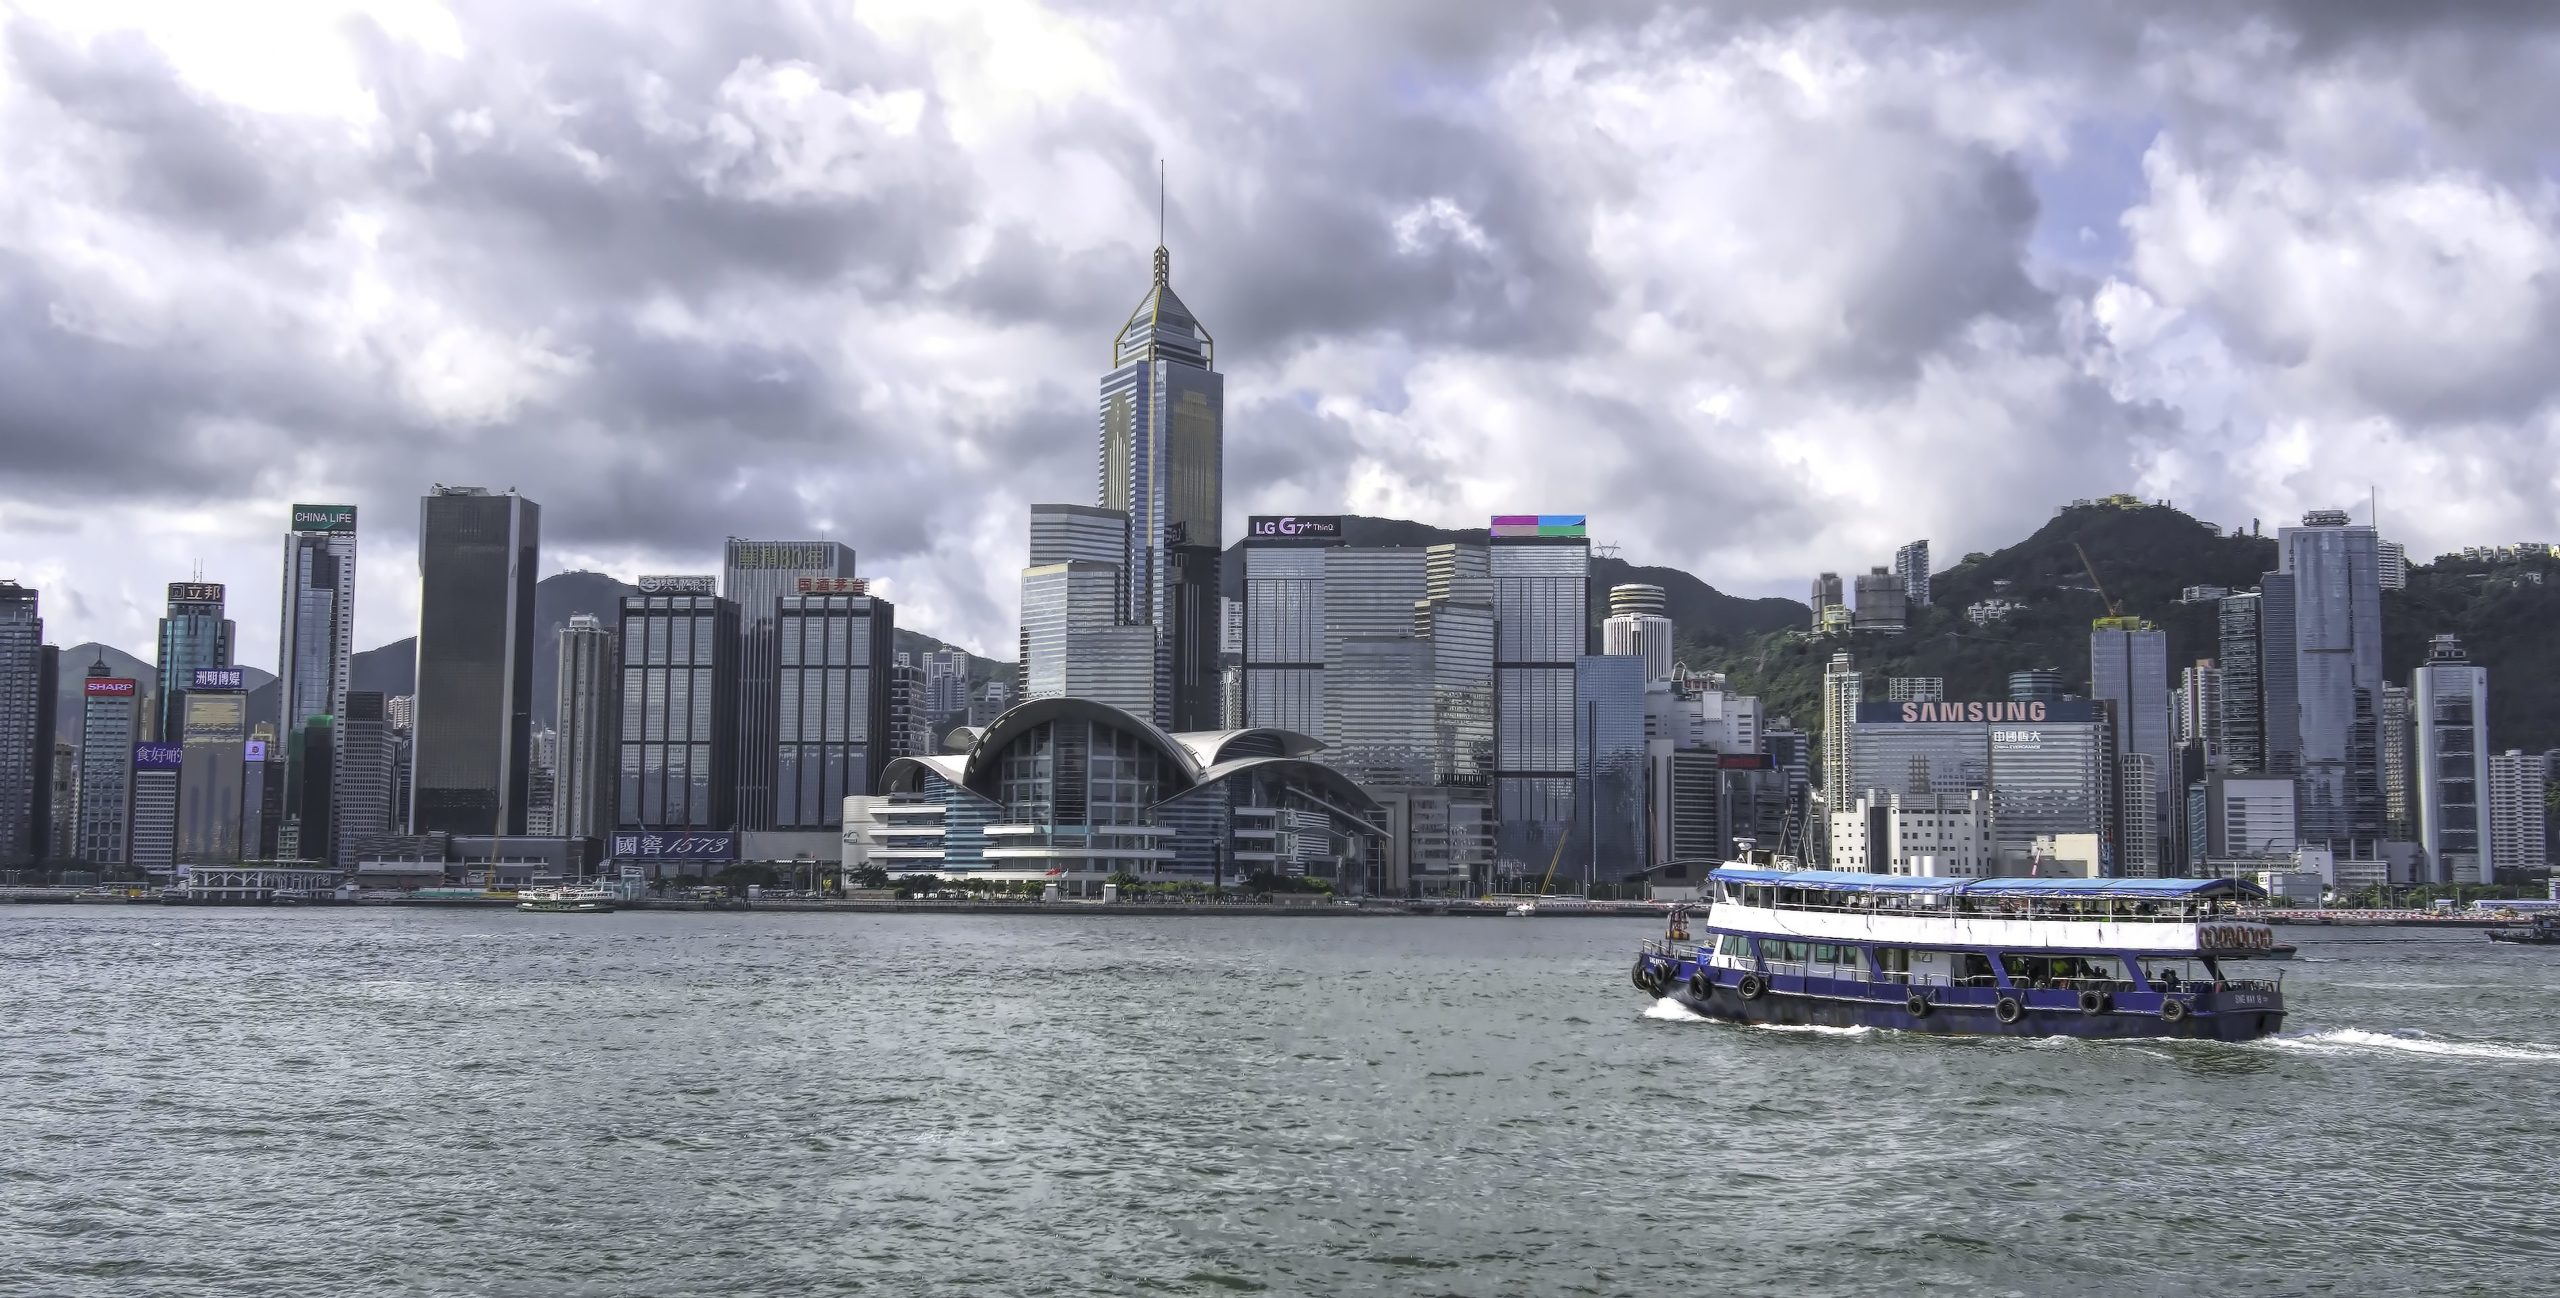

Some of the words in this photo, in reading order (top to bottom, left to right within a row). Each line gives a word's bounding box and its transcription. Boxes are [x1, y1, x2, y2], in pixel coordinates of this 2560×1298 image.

[295, 512, 328, 522] CHINA
[330, 513, 352, 523] LIFE
[1255, 521, 1276, 535] LG
[1313, 523, 1335, 531] ThinQ
[798, 578, 865, 592] 国酒茅台
[186, 585, 220, 600] 立邦
[195, 671, 240, 685] 洲明傳媒
[87, 683, 133, 691] SHARP
[1902, 701, 2046, 722] SAMSUNG
